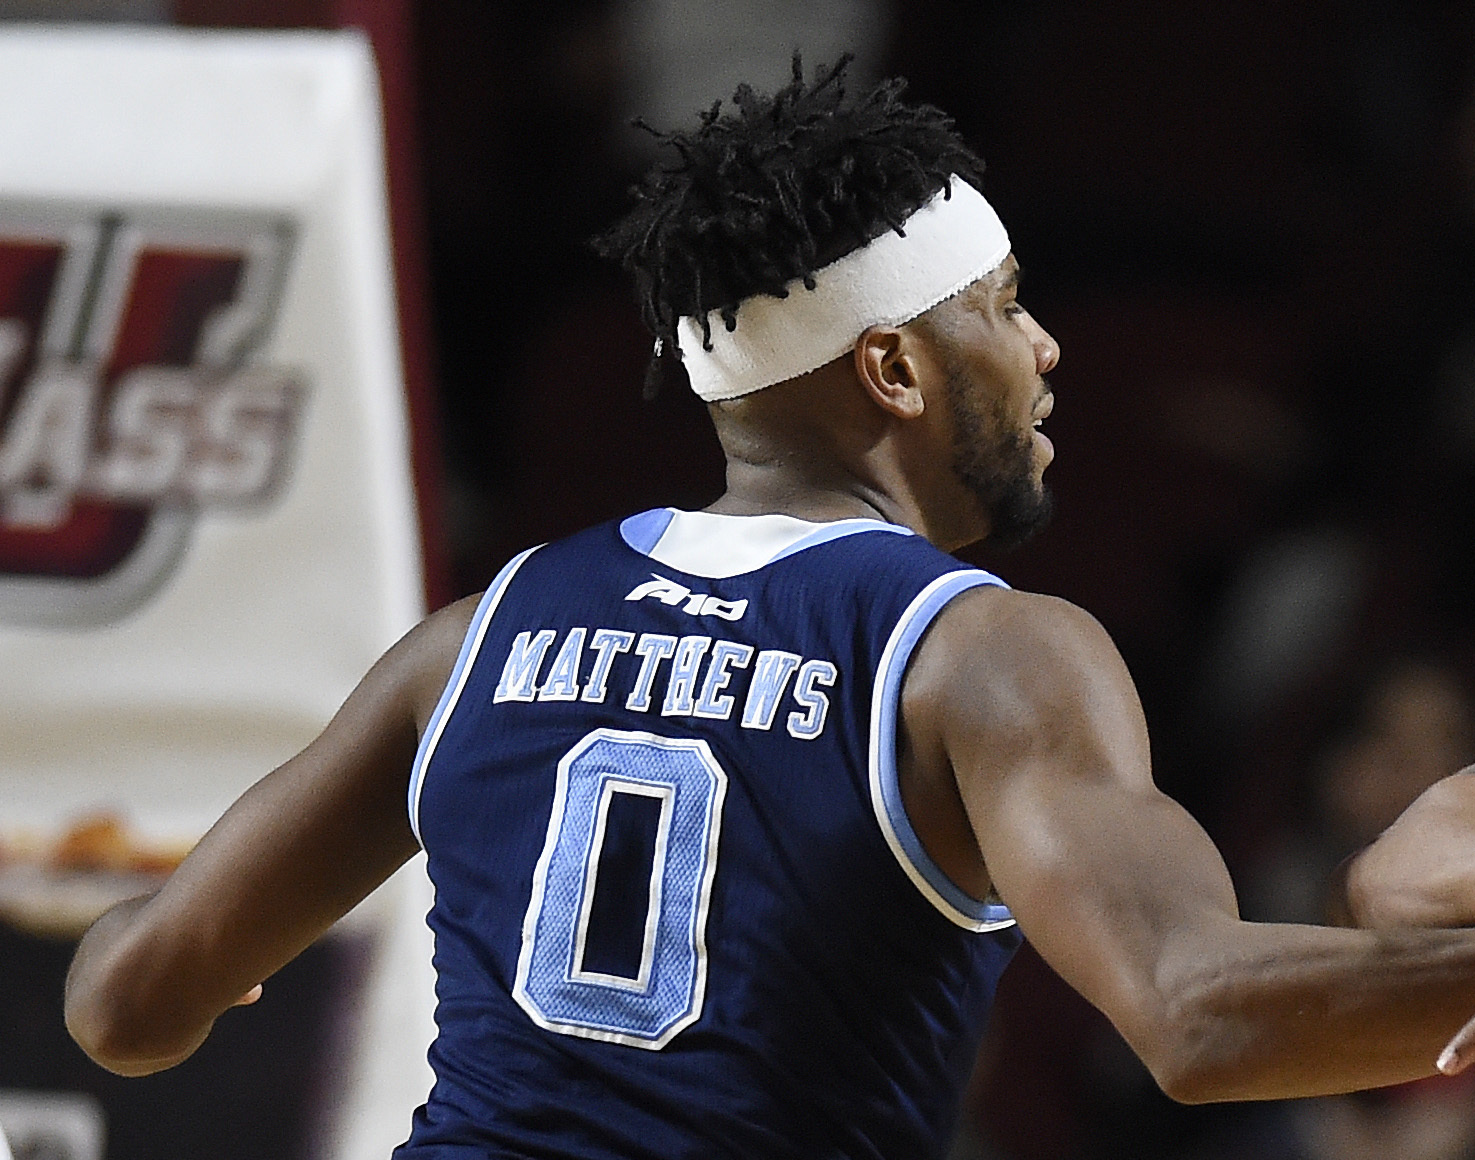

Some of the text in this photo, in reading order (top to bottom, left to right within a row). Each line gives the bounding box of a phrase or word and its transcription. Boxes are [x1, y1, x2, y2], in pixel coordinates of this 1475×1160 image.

[0, 365, 312, 525] ASS
[625, 573, 749, 621] A10
[493, 627, 837, 740] MATTHEWS
[512, 728, 728, 1050] 0
